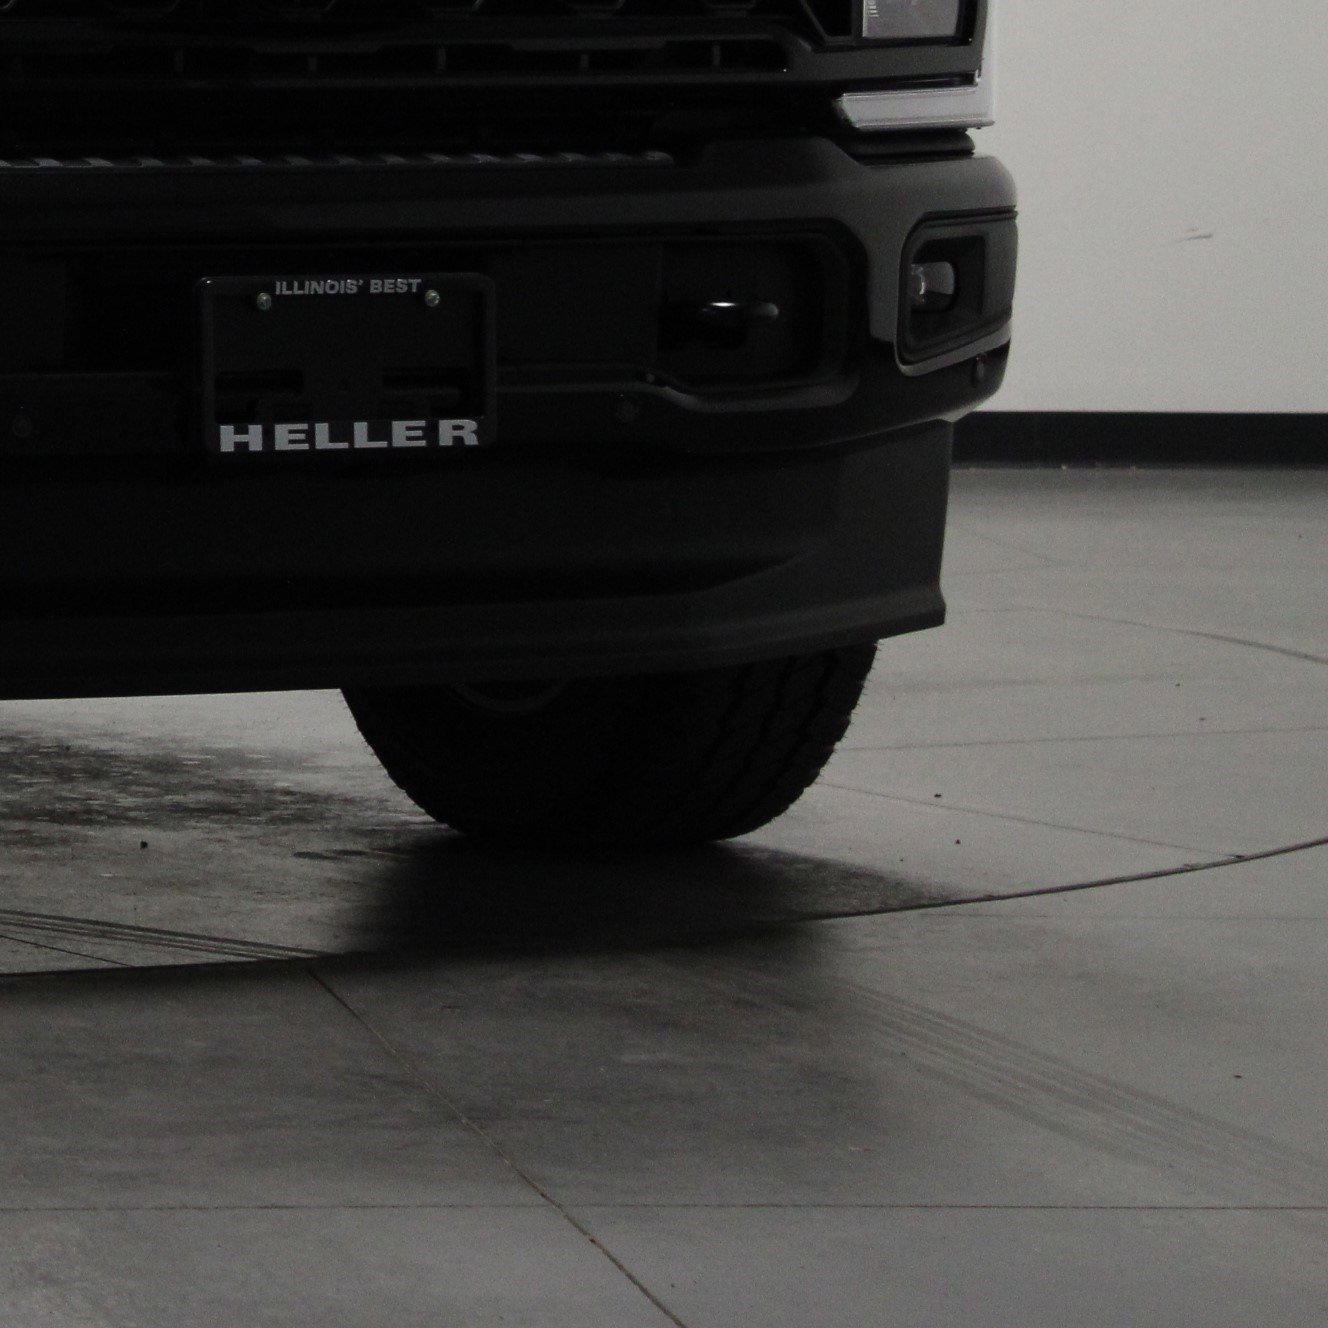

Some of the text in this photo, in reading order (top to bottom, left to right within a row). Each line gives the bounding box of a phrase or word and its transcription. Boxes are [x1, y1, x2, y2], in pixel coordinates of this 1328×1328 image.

[275, 278, 422, 295] ILLINOIS' BEST
[220, 419, 479, 452] HELLER
